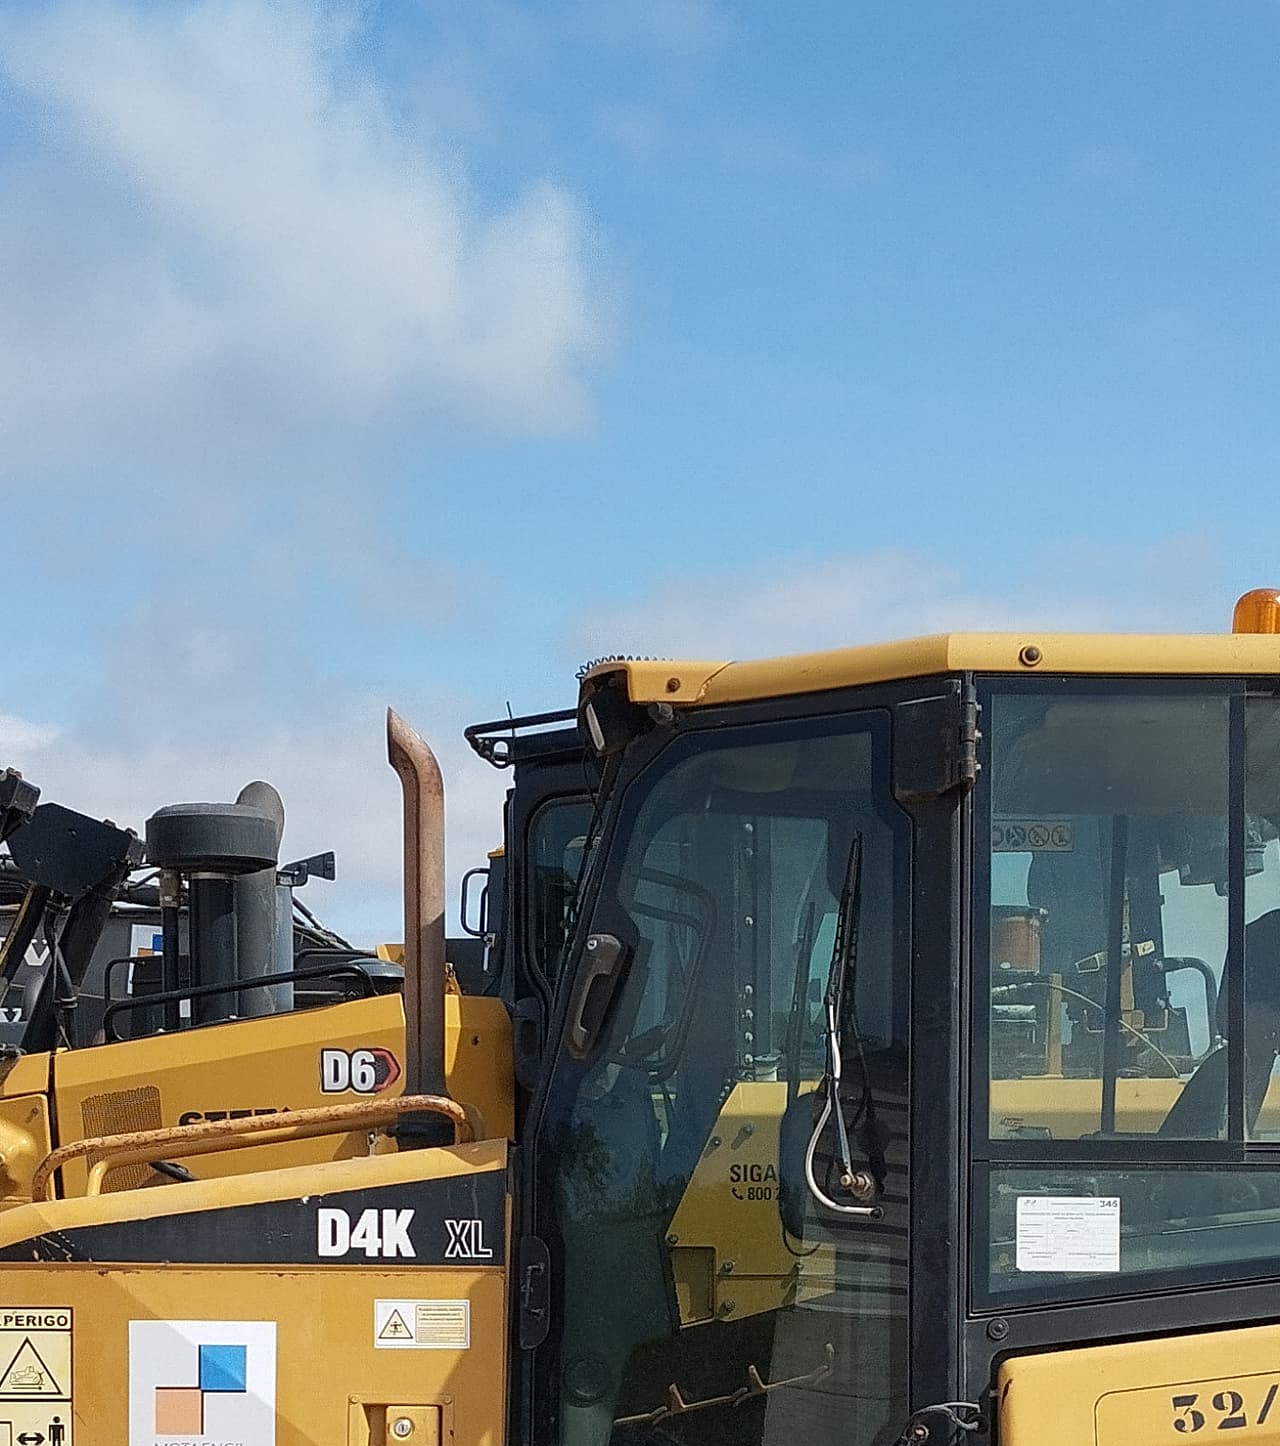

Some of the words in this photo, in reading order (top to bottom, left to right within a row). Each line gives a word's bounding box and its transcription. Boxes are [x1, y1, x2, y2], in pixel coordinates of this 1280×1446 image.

[322, 1048, 377, 1093] D6
[747, 1186, 772, 1201] 800
[317, 1208, 417, 1258] D4K
[443, 1219, 493, 1258] XL
[3, 1315, 68, 1327] PERIGO
